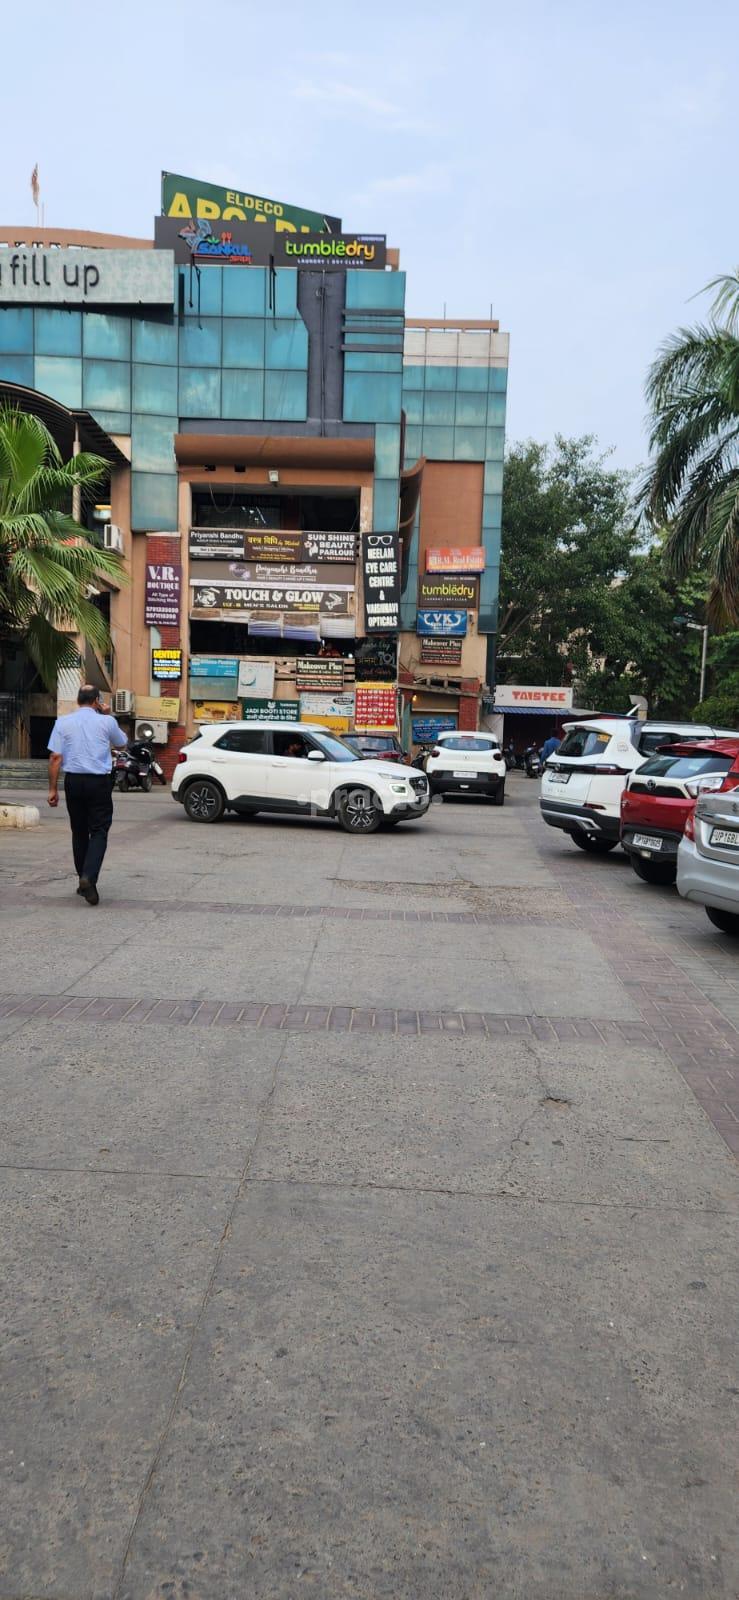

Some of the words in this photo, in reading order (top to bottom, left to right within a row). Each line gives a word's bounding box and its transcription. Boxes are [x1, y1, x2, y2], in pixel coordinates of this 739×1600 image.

[226, 191, 284, 217] ELDECO
[285, 240, 375, 261] tumblëdry
[10, 254, 51, 286] fill
[63, 264, 100, 295] up
[368, 548, 394, 559] NEELAM
[148, 566, 180, 581] V.R.
[366, 562, 378, 574] EYE
[380, 562, 397, 573] CARE
[147, 582, 179, 591] BOUTIQUE
[369, 576, 394, 588] CENTRE
[224, 588, 270, 600] TOUCH
[272, 590, 283, 602] &
[285, 590, 324, 602] GLOW
[422, 584, 474, 598] tumblëdry
[366, 603, 398, 614] VAISHNAVI
[368, 616, 398, 627] OPTICALS
[423, 639, 448, 647] Makeover
[154, 650, 181, 659] DENTIST
[298, 660, 328, 670] Makeover
[329, 661, 342, 670] Plus
[512, 690, 566, 702] TAISTEE
